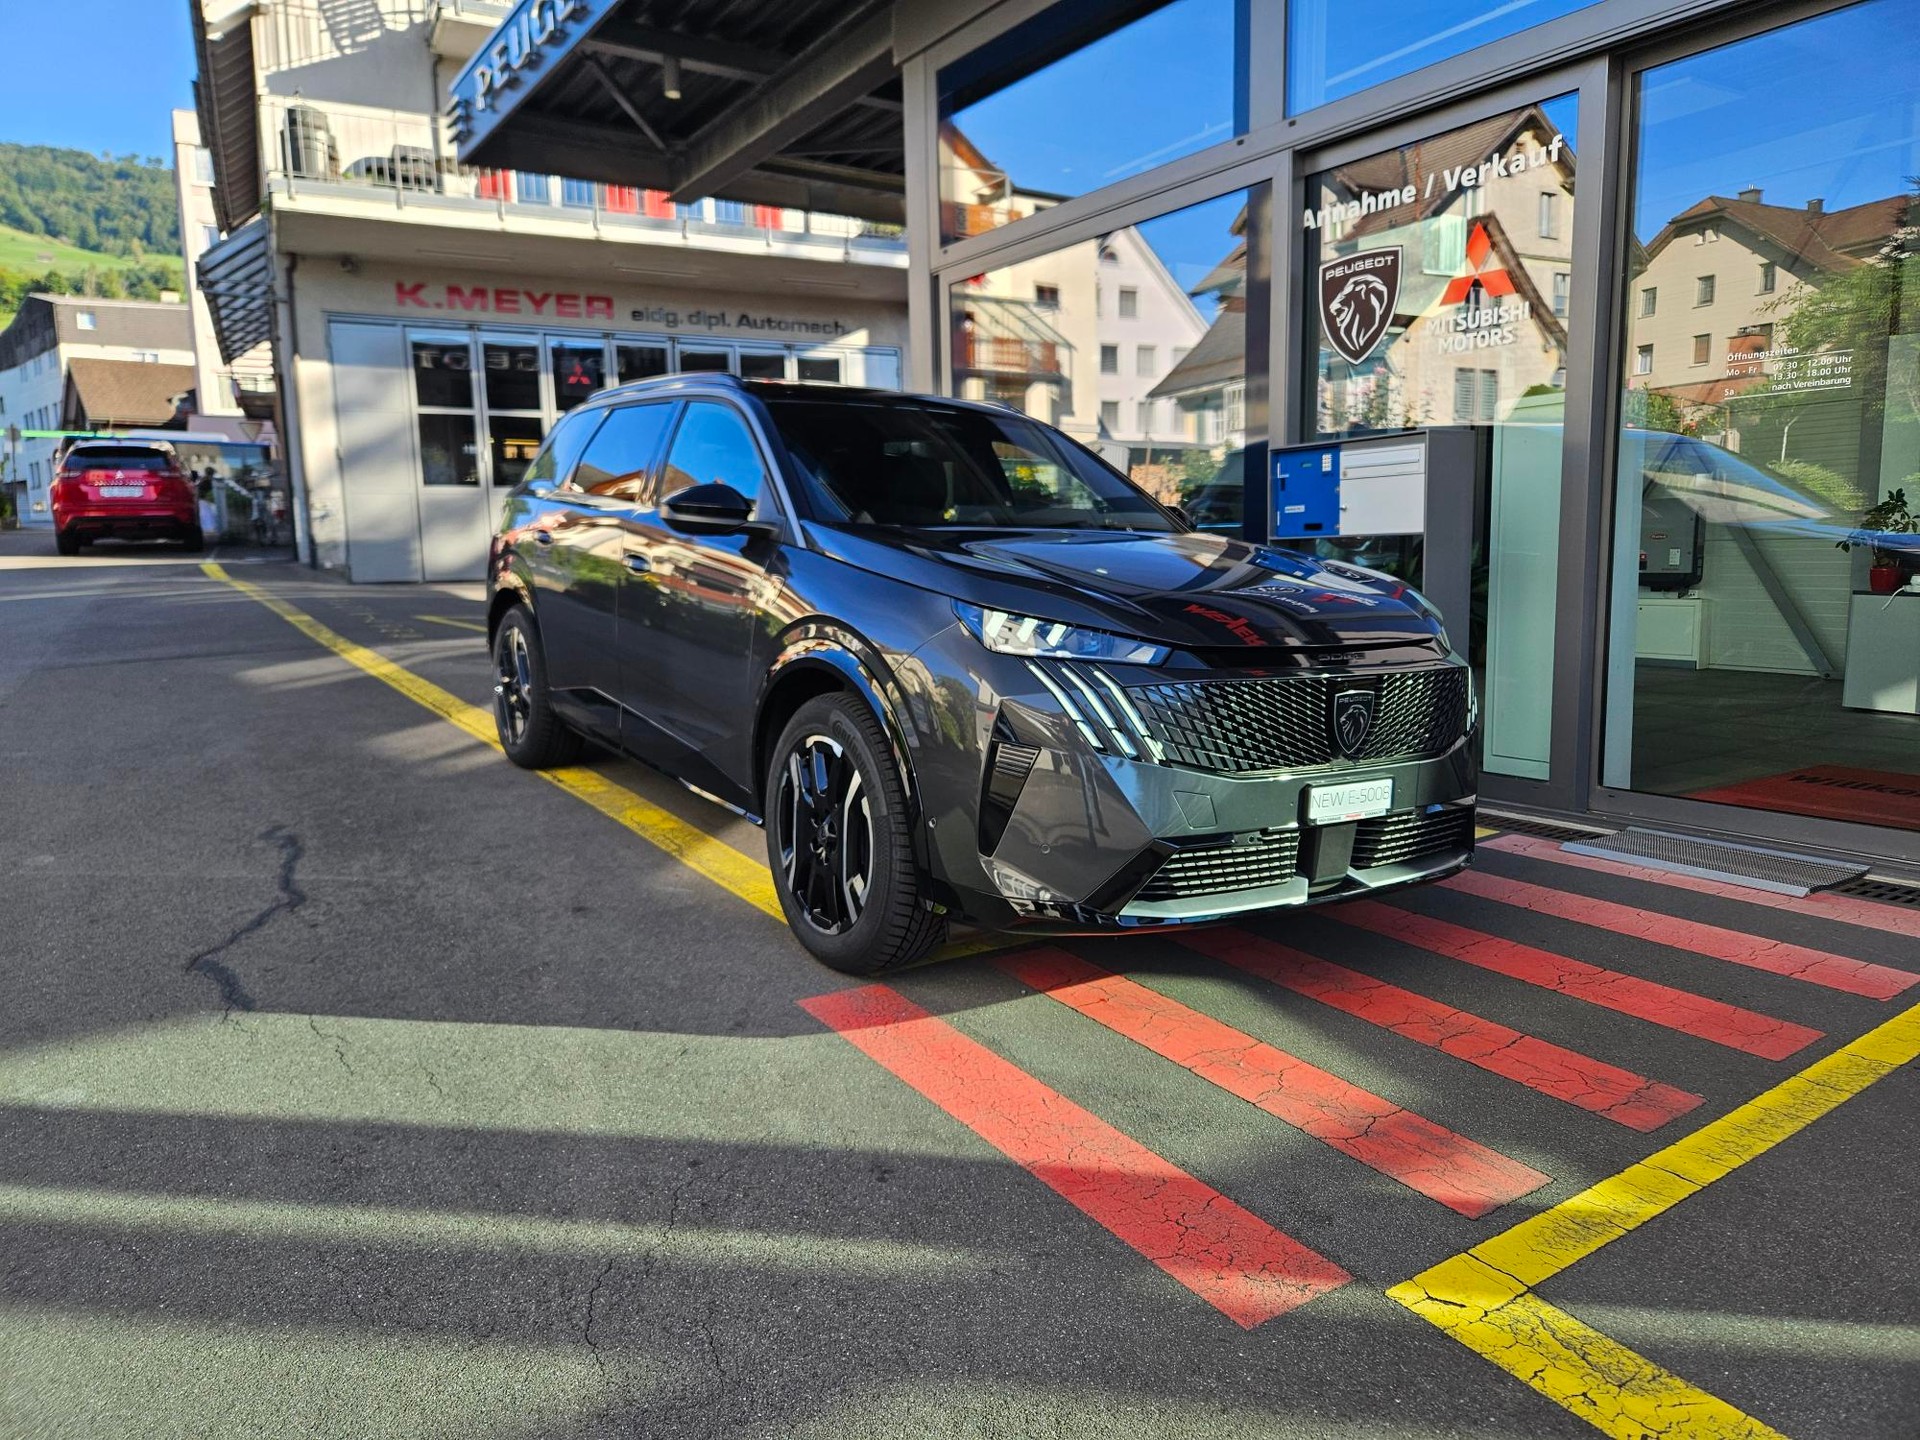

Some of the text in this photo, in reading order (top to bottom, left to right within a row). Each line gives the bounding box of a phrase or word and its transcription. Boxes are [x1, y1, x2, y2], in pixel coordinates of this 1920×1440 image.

[1303, 134, 1563, 231] Annahme / Verkauf
[1325, 255, 1395, 281] PEUGEOT
[395, 282, 615, 320] K.MEYER
[632, 308, 684, 328] eidg.
[688, 310, 731, 330] dipl.
[1426, 301, 1530, 335] MITSUBISHI
[1438, 326, 1516, 354] MOTORS
[1726, 368, 1740, 377] Mo
[1748, 366, 1758, 375] Fr
[1773, 361, 1798, 371] 07.30
[1807, 357, 1832, 367] 12.00
[1834, 355, 1853, 365] Uhr
[1773, 371, 1797, 381] 13.30
[1807, 368, 1832, 377] 18.00
[1834, 365, 1853, 374] Uhr
[1724, 376, 1852, 396] Sa nach Vereinbarung
[1338, 695, 1372, 704] PEUGEOT
[1788, 775, 1920, 797] Willko
[1311, 791, 1345, 808] NEW
